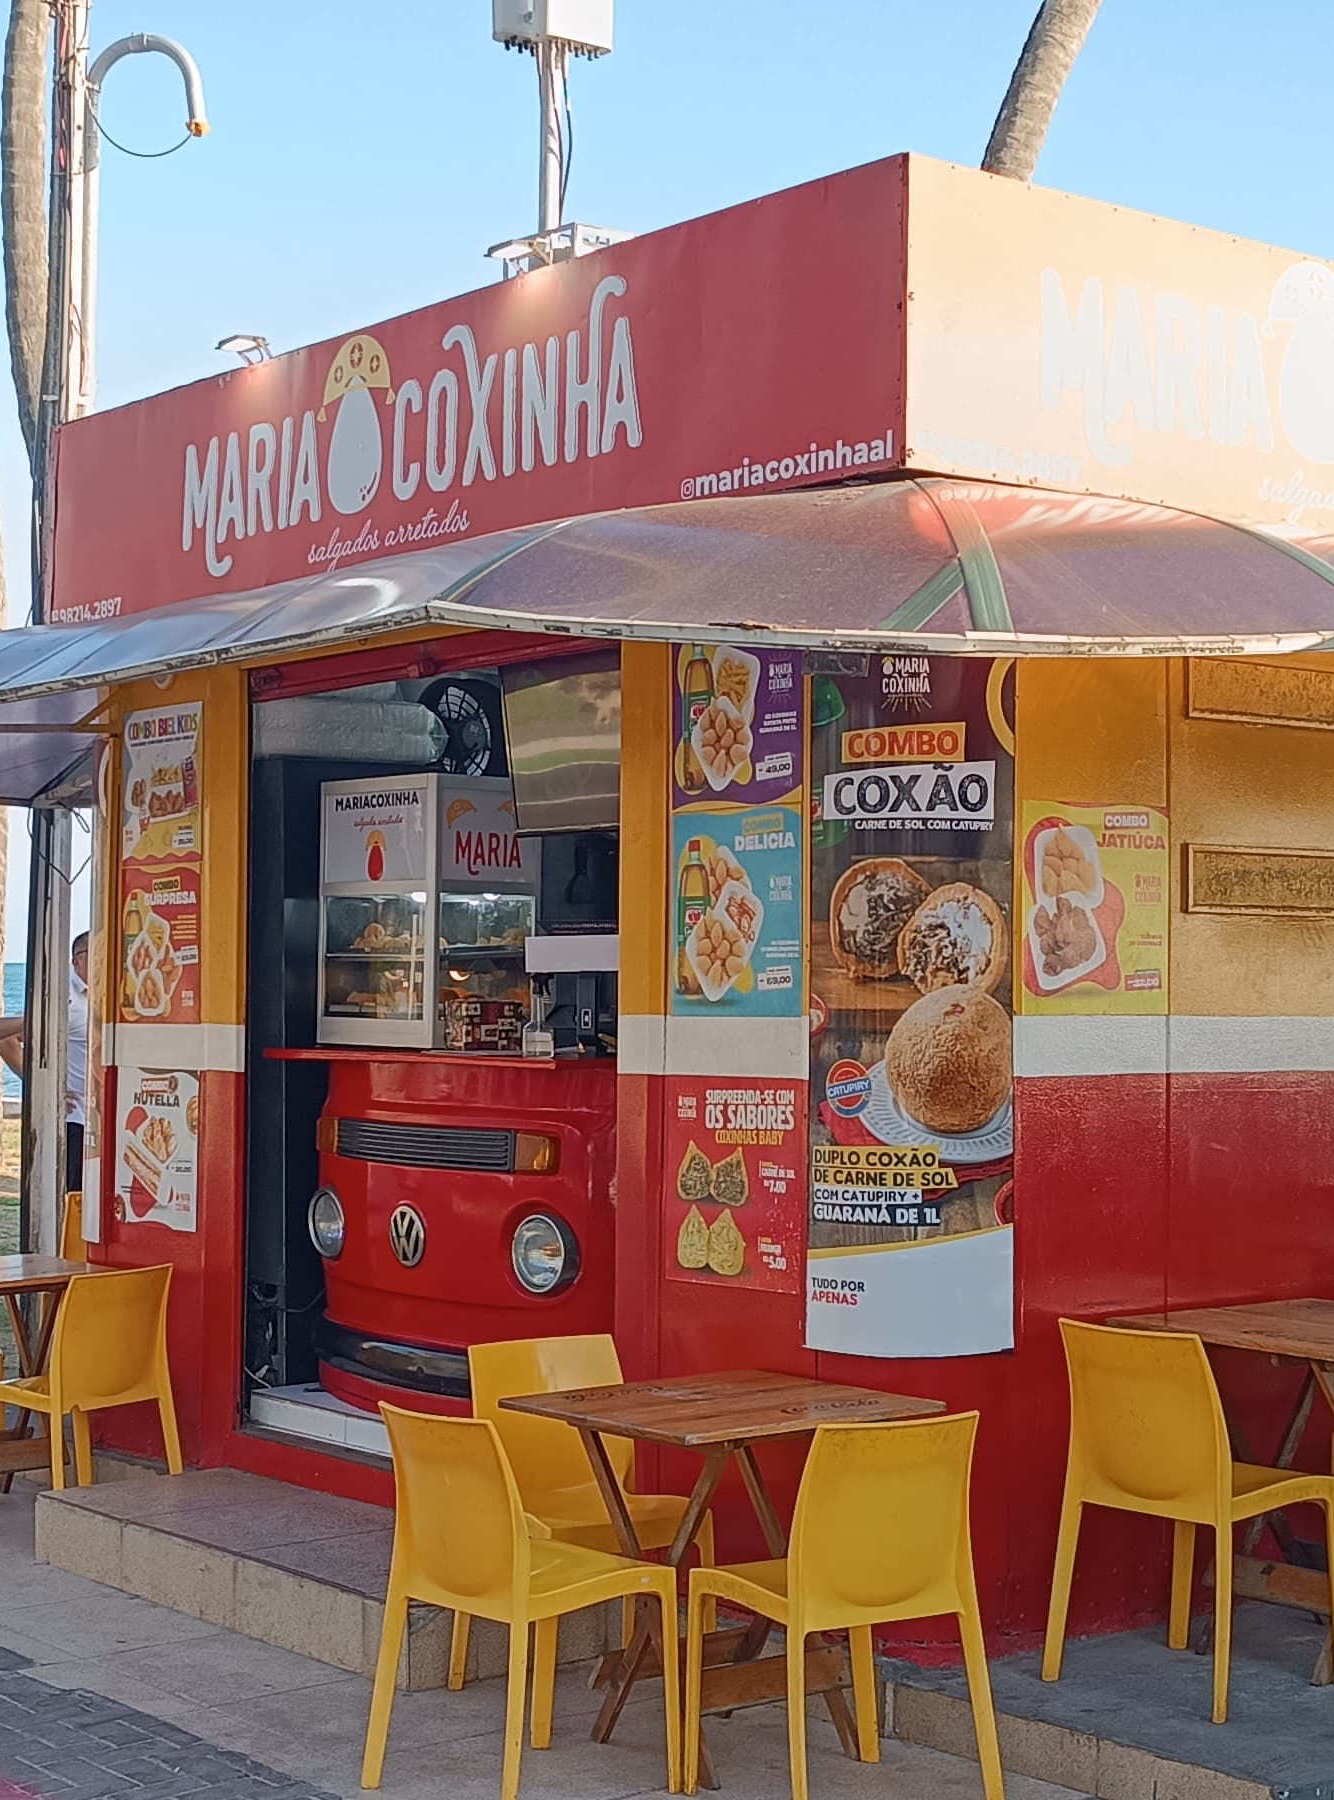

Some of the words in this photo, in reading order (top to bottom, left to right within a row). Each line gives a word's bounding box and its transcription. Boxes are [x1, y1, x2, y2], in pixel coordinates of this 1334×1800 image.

[1040, 267, 1275, 469] MARIA
[182, 410, 322, 577] MARIA
[392, 276, 641, 500] COXINHA
[308, 520, 380, 572] salgados
[385, 500, 470, 546] arretados
[895, 657, 930, 676] MARIA
[882, 673, 931, 693] COXINHA
[848, 730, 959, 758] COMBO
[834, 765, 988, 815] COXÃO
[335, 791, 420, 811] MARIACOXINHA
[855, 819, 888, 830] CARNE
[889, 819, 902, 829] DE
[904, 819, 925, 829] SOL
[927, 819, 951, 830] COM
[952, 819, 994, 831] CATUPIRY
[1105, 815, 1148, 827] COMBO
[1096, 831, 1166, 850] JATIÚCA
[455, 831, 522, 876] MARIA
[705, 1089, 776, 1105] SURPREENDA-SE
[776, 1090, 795, 1105] COM
[828, 1080, 870, 1098] CATUPIRY
[133, 1092, 181, 1108] NUTELLA
[705, 1105, 725, 1129] OS
[726, 1105, 795, 1131] SABORES
[715, 1130, 758, 1145] COXINHAS
[759, 1130, 784, 1146] BABY
[814, 1150, 861, 1166] DUPLO
[866, 1148, 937, 1168] COXÃO
[814, 1170, 831, 1184] DE
[833, 1170, 887, 1185] CARNE
[893, 1171, 914, 1186] DE
[920, 1172, 954, 1186] SOL
[814, 1188, 839, 1201] COM
[841, 1190, 908, 1202] CATUPIRY
[813, 1203, 891, 1225] GUARANÁ
[895, 1207, 917, 1224] DE
[923, 1207, 941, 1225] 1L
[811, 1276, 838, 1290] TUDO
[840, 1278, 865, 1293] POR
[811, 1290, 858, 1306] APENAS
